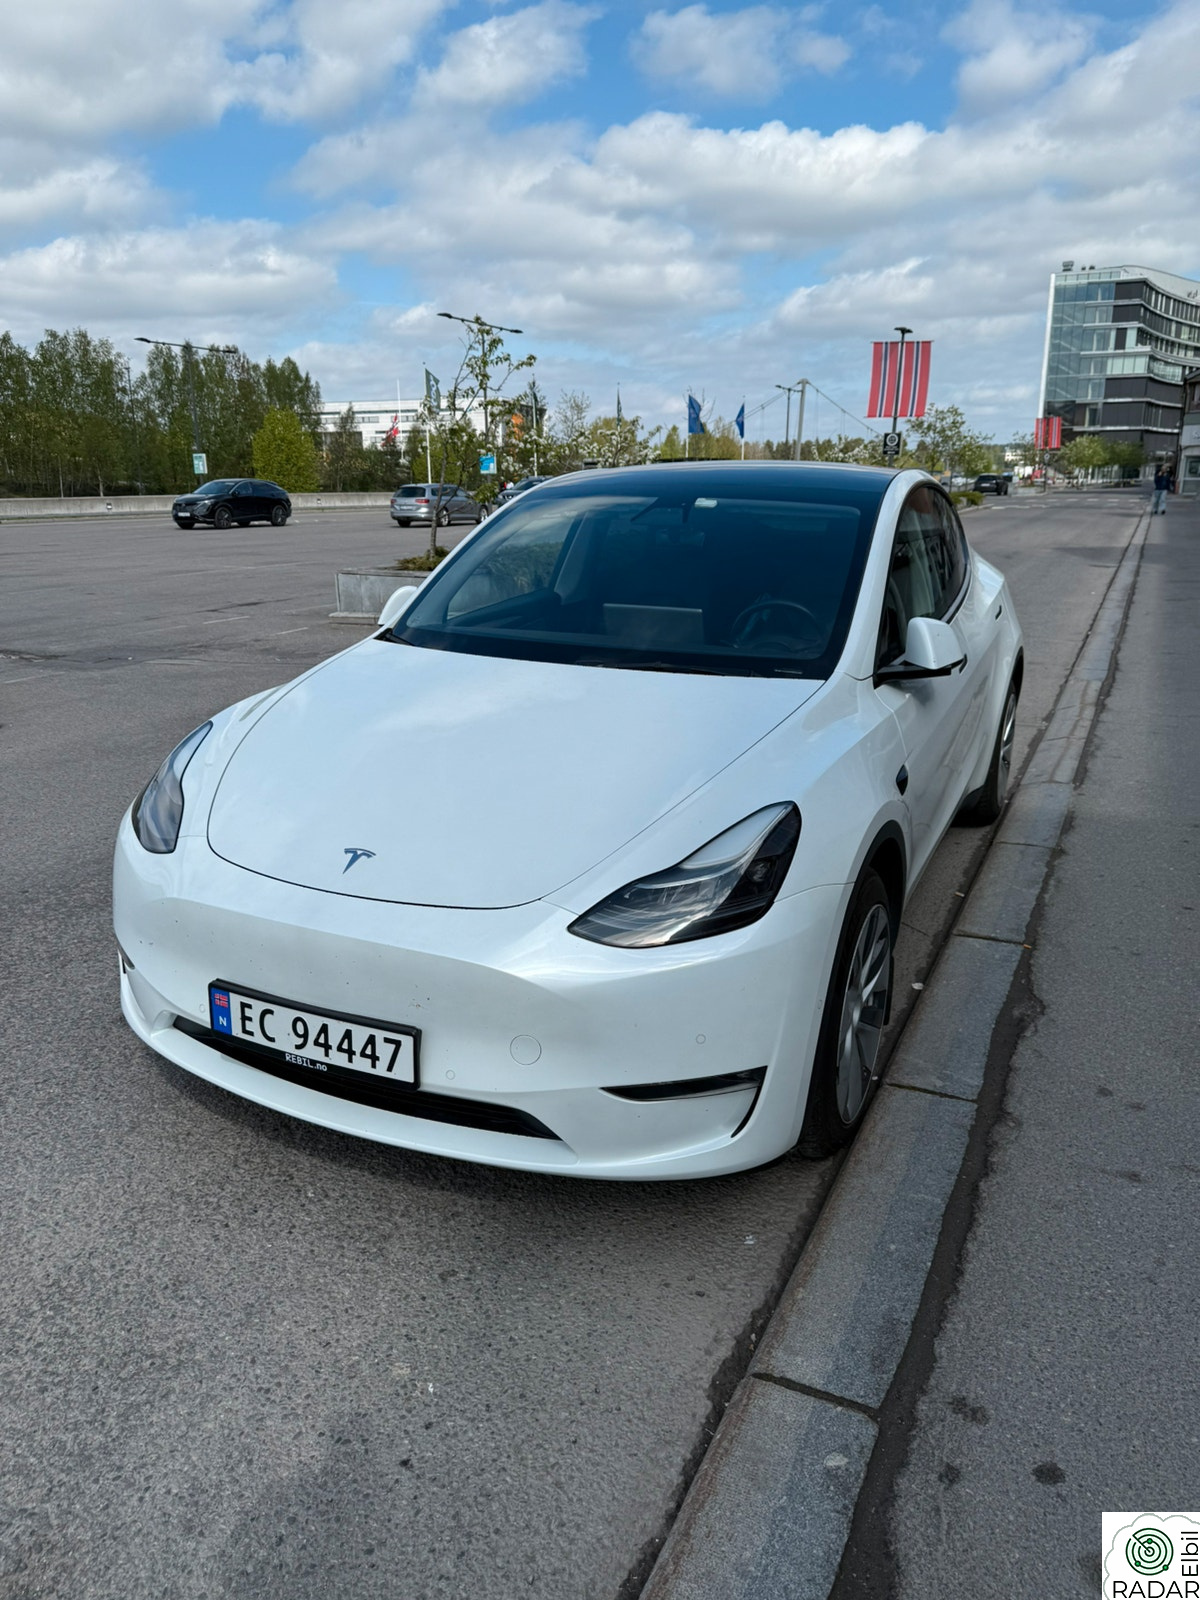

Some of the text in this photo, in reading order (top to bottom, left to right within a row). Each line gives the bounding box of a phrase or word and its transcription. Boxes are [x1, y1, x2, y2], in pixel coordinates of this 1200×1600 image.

[219, 1015, 227, 1027] N
[240, 1001, 402, 1073] EC 94447
[285, 1053, 328, 1072] REBIL.no
